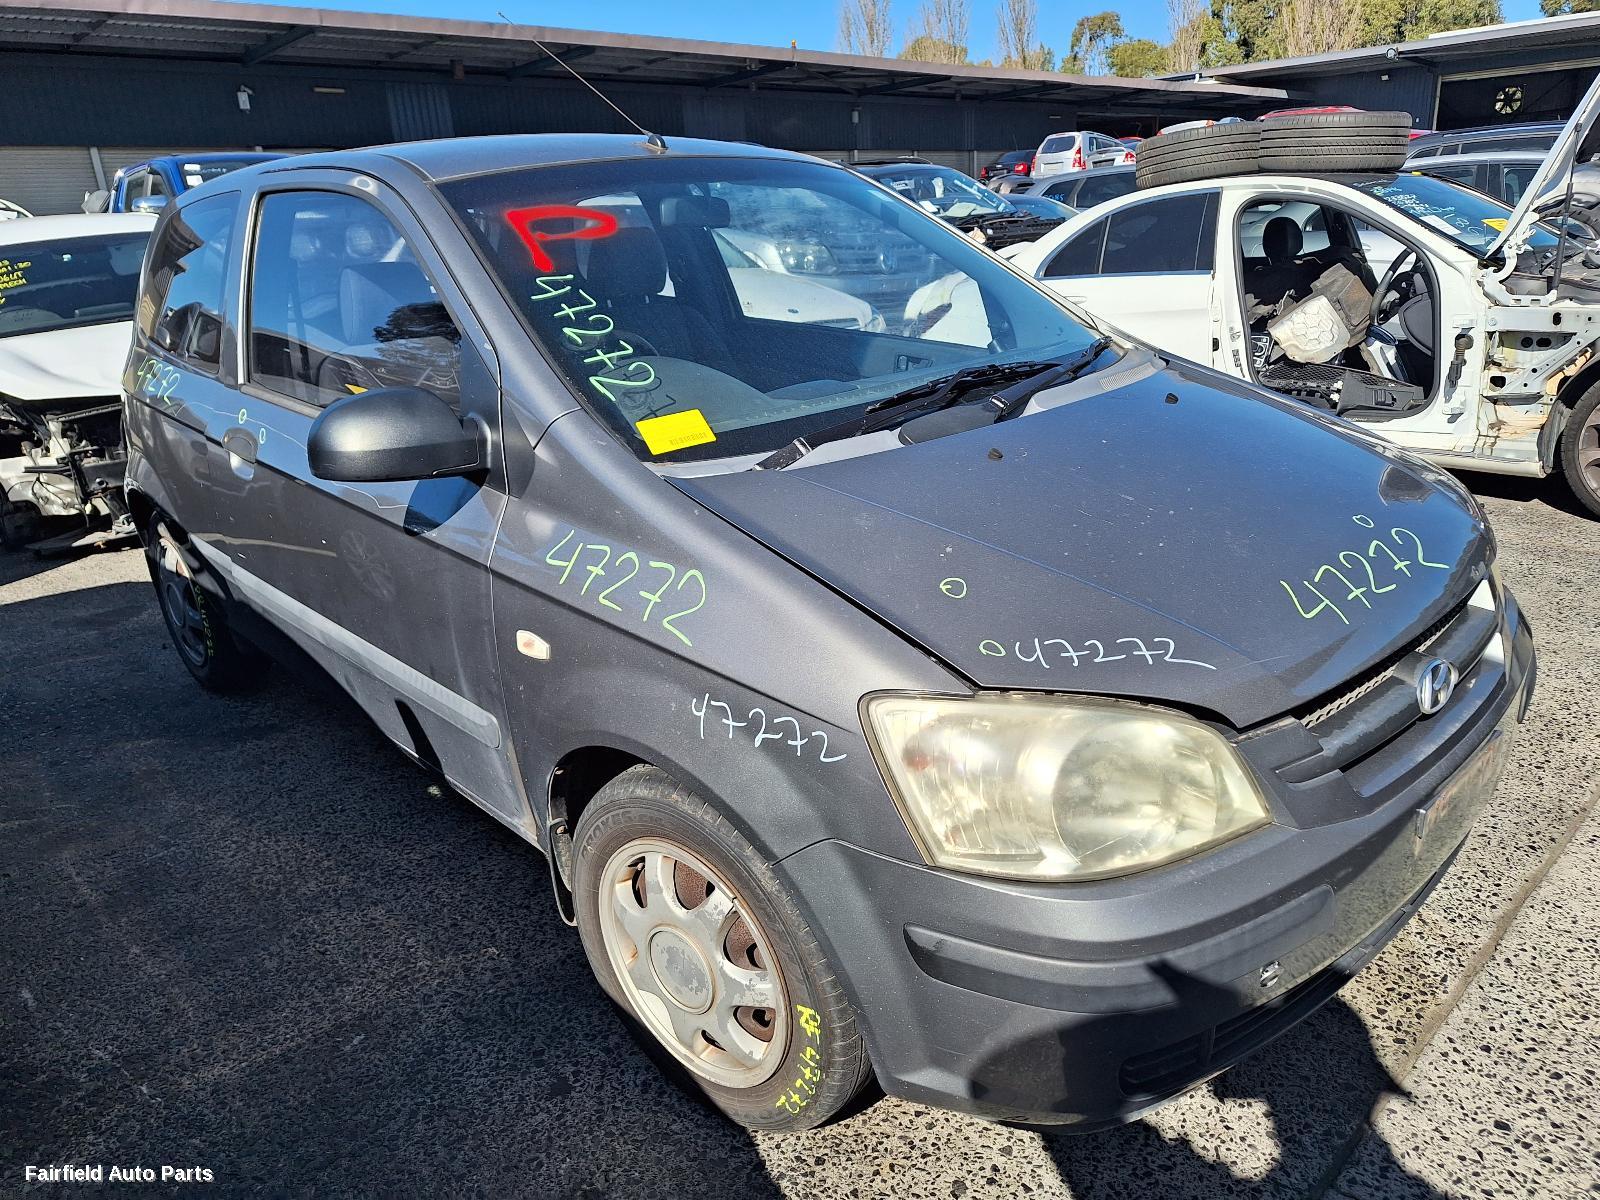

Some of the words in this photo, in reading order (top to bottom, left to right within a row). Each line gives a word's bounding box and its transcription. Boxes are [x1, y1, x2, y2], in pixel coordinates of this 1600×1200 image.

[505, 205, 618, 273] P
[530, 273, 657, 403] 47272
[134, 355, 181, 407] 47272
[545, 529, 706, 647] 47272
[1280, 526, 1450, 625] 47272
[1014, 637, 1218, 671] 47272
[691, 692, 848, 763] 47272
[775, 1045, 823, 1116] 47272
